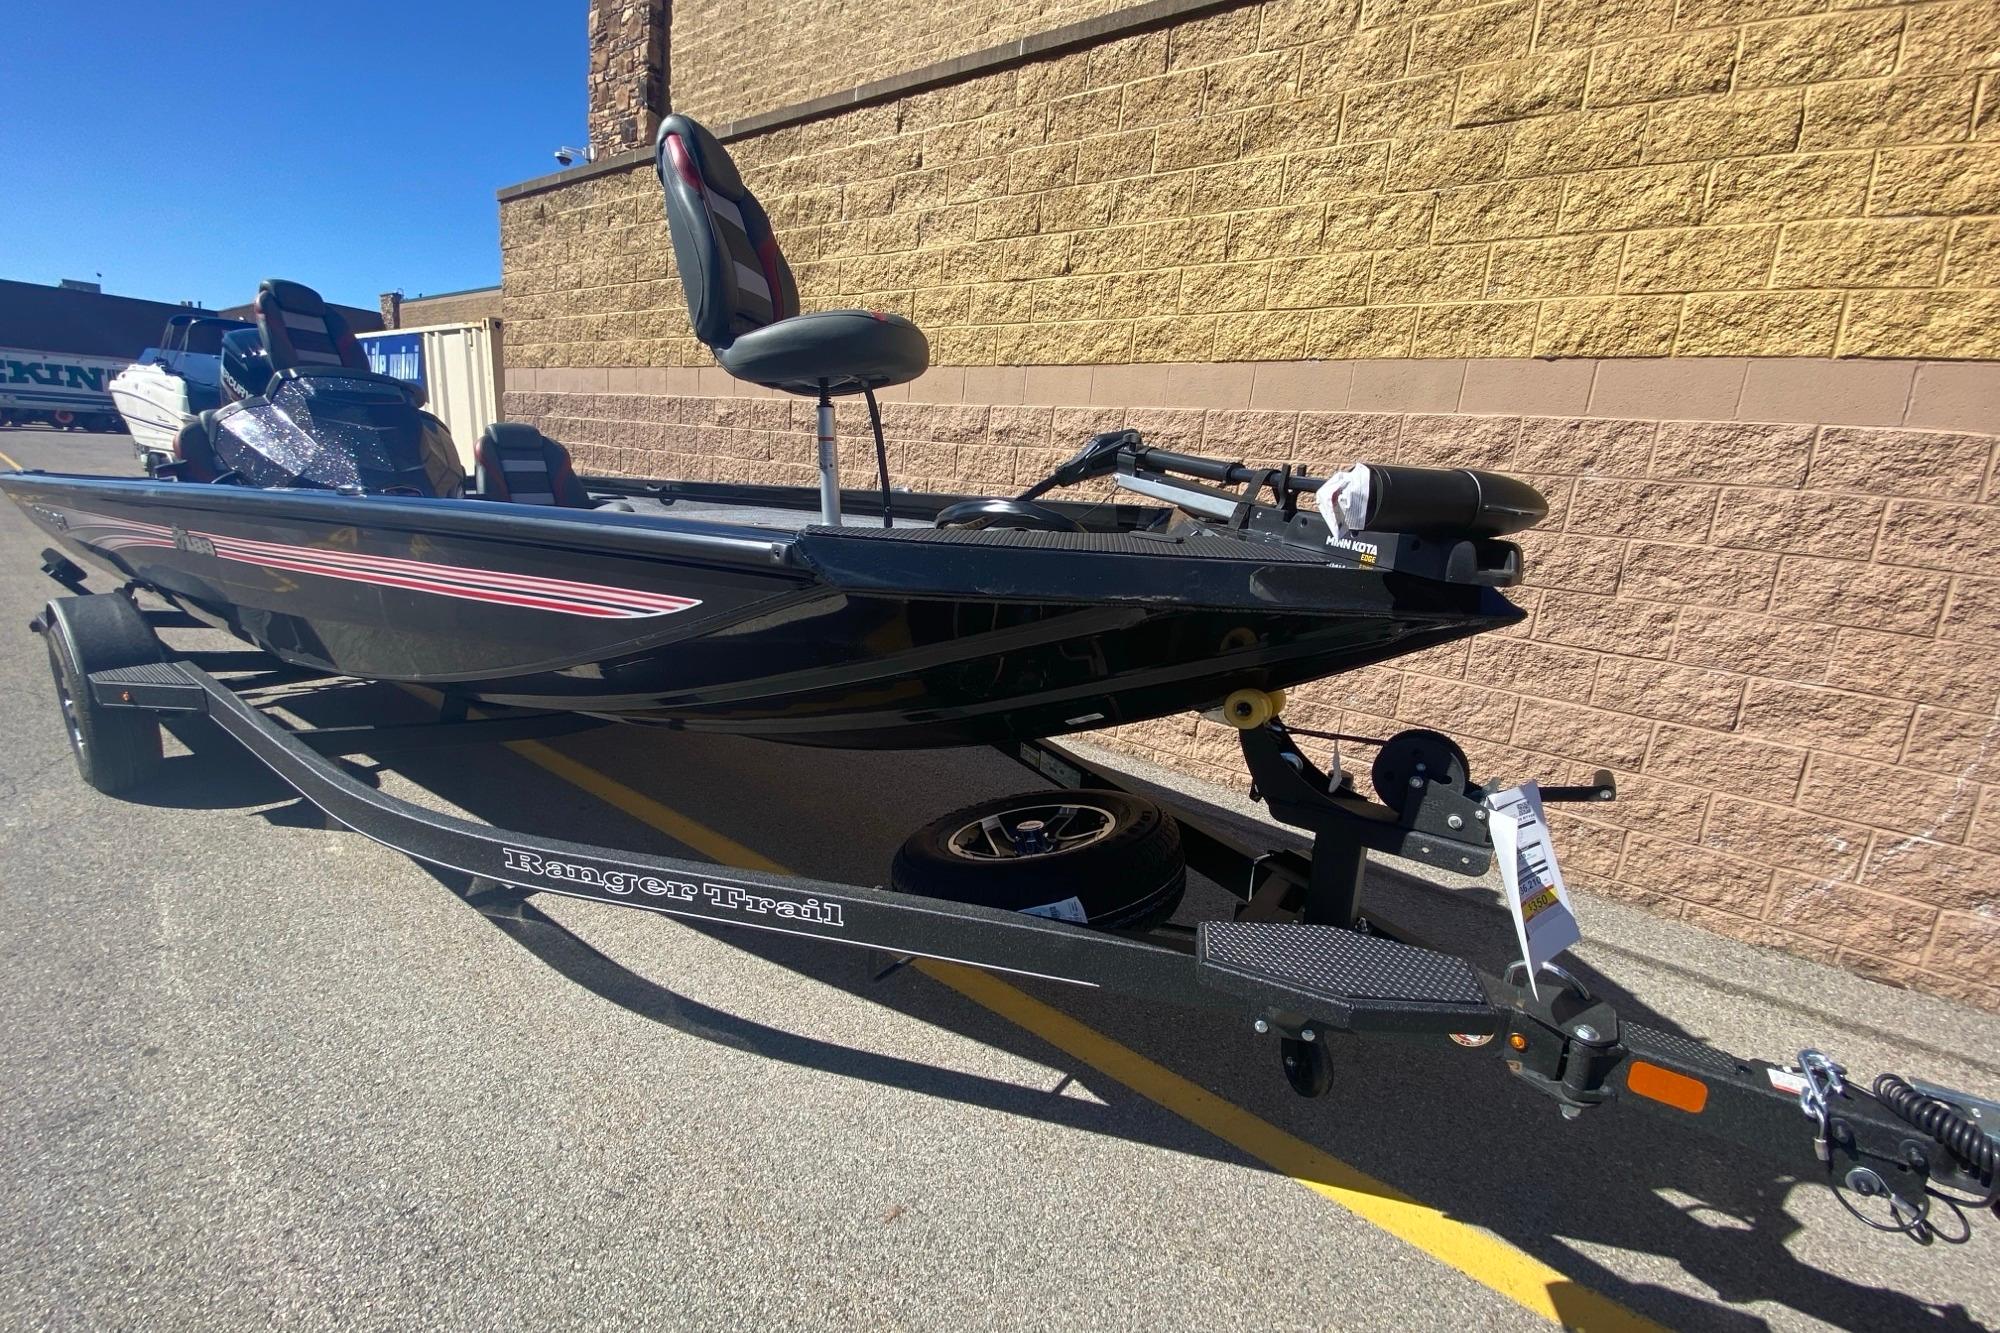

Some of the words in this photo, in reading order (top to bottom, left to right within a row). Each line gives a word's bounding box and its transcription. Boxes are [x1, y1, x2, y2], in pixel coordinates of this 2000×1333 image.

[389, 345, 419, 379] mini
[1326, 535, 1352, 550] MINN
[1351, 541, 1378, 556] KOTA
[1361, 553, 1377, 564] EDGE
[503, 848, 698, 901] Ranger
[703, 882, 845, 927] Trail
[1528, 894, 1548, 911] $350
